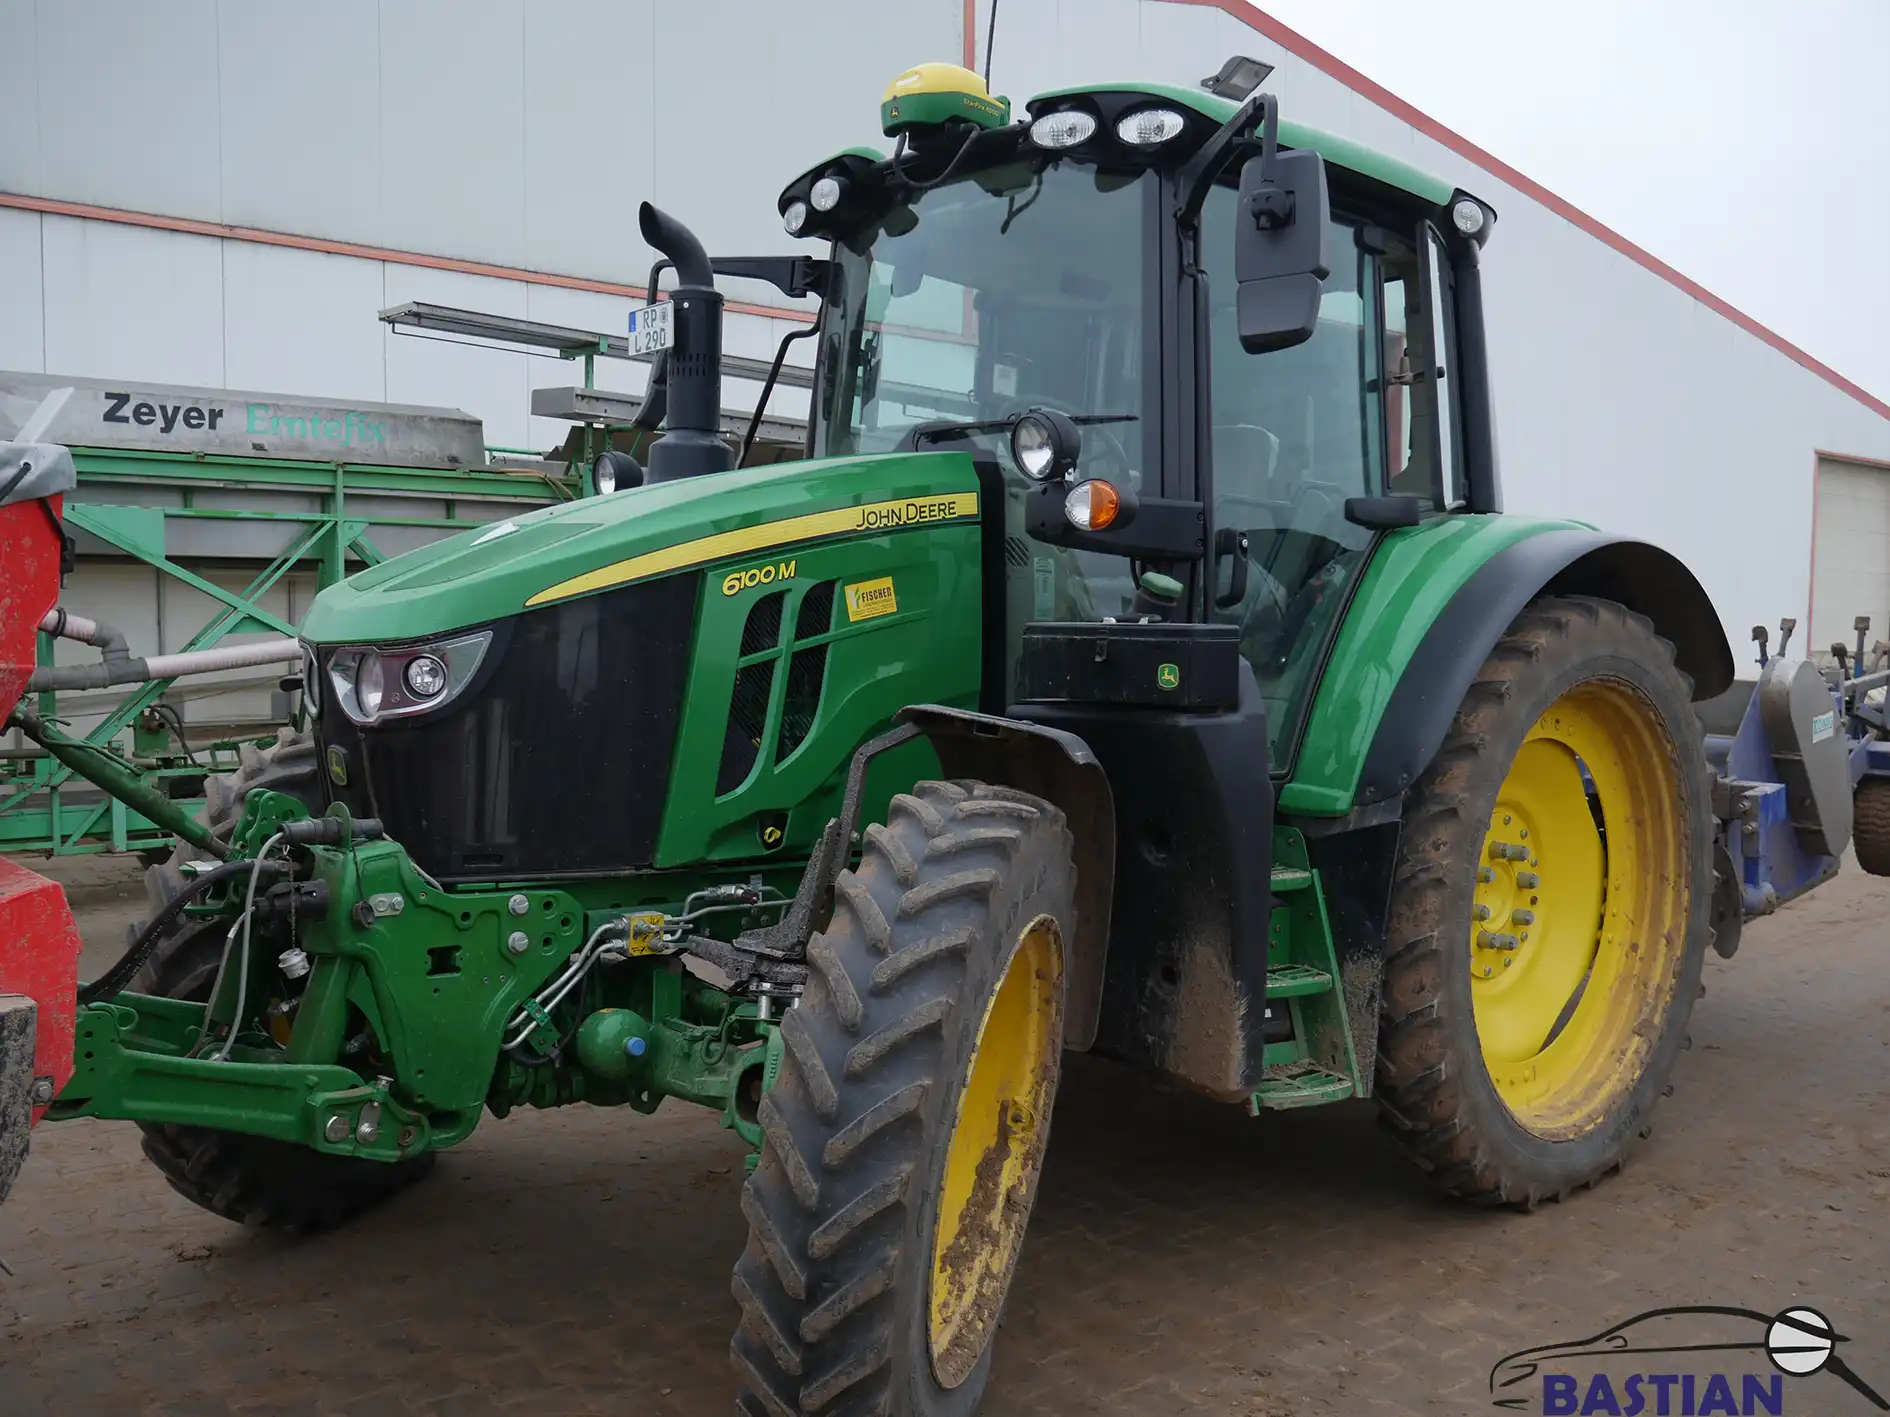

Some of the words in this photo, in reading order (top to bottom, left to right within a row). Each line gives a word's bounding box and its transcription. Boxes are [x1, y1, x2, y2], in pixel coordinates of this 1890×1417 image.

[643, 308, 657, 329] RP
[635, 335, 641, 353] L
[645, 327, 666, 351] 290
[102, 392, 224, 433] Zeyer
[246, 404, 388, 447] Erntefix
[856, 506, 902, 529] JOHN
[905, 501, 957, 521] DEERE
[861, 586, 893, 602] FISCHER
